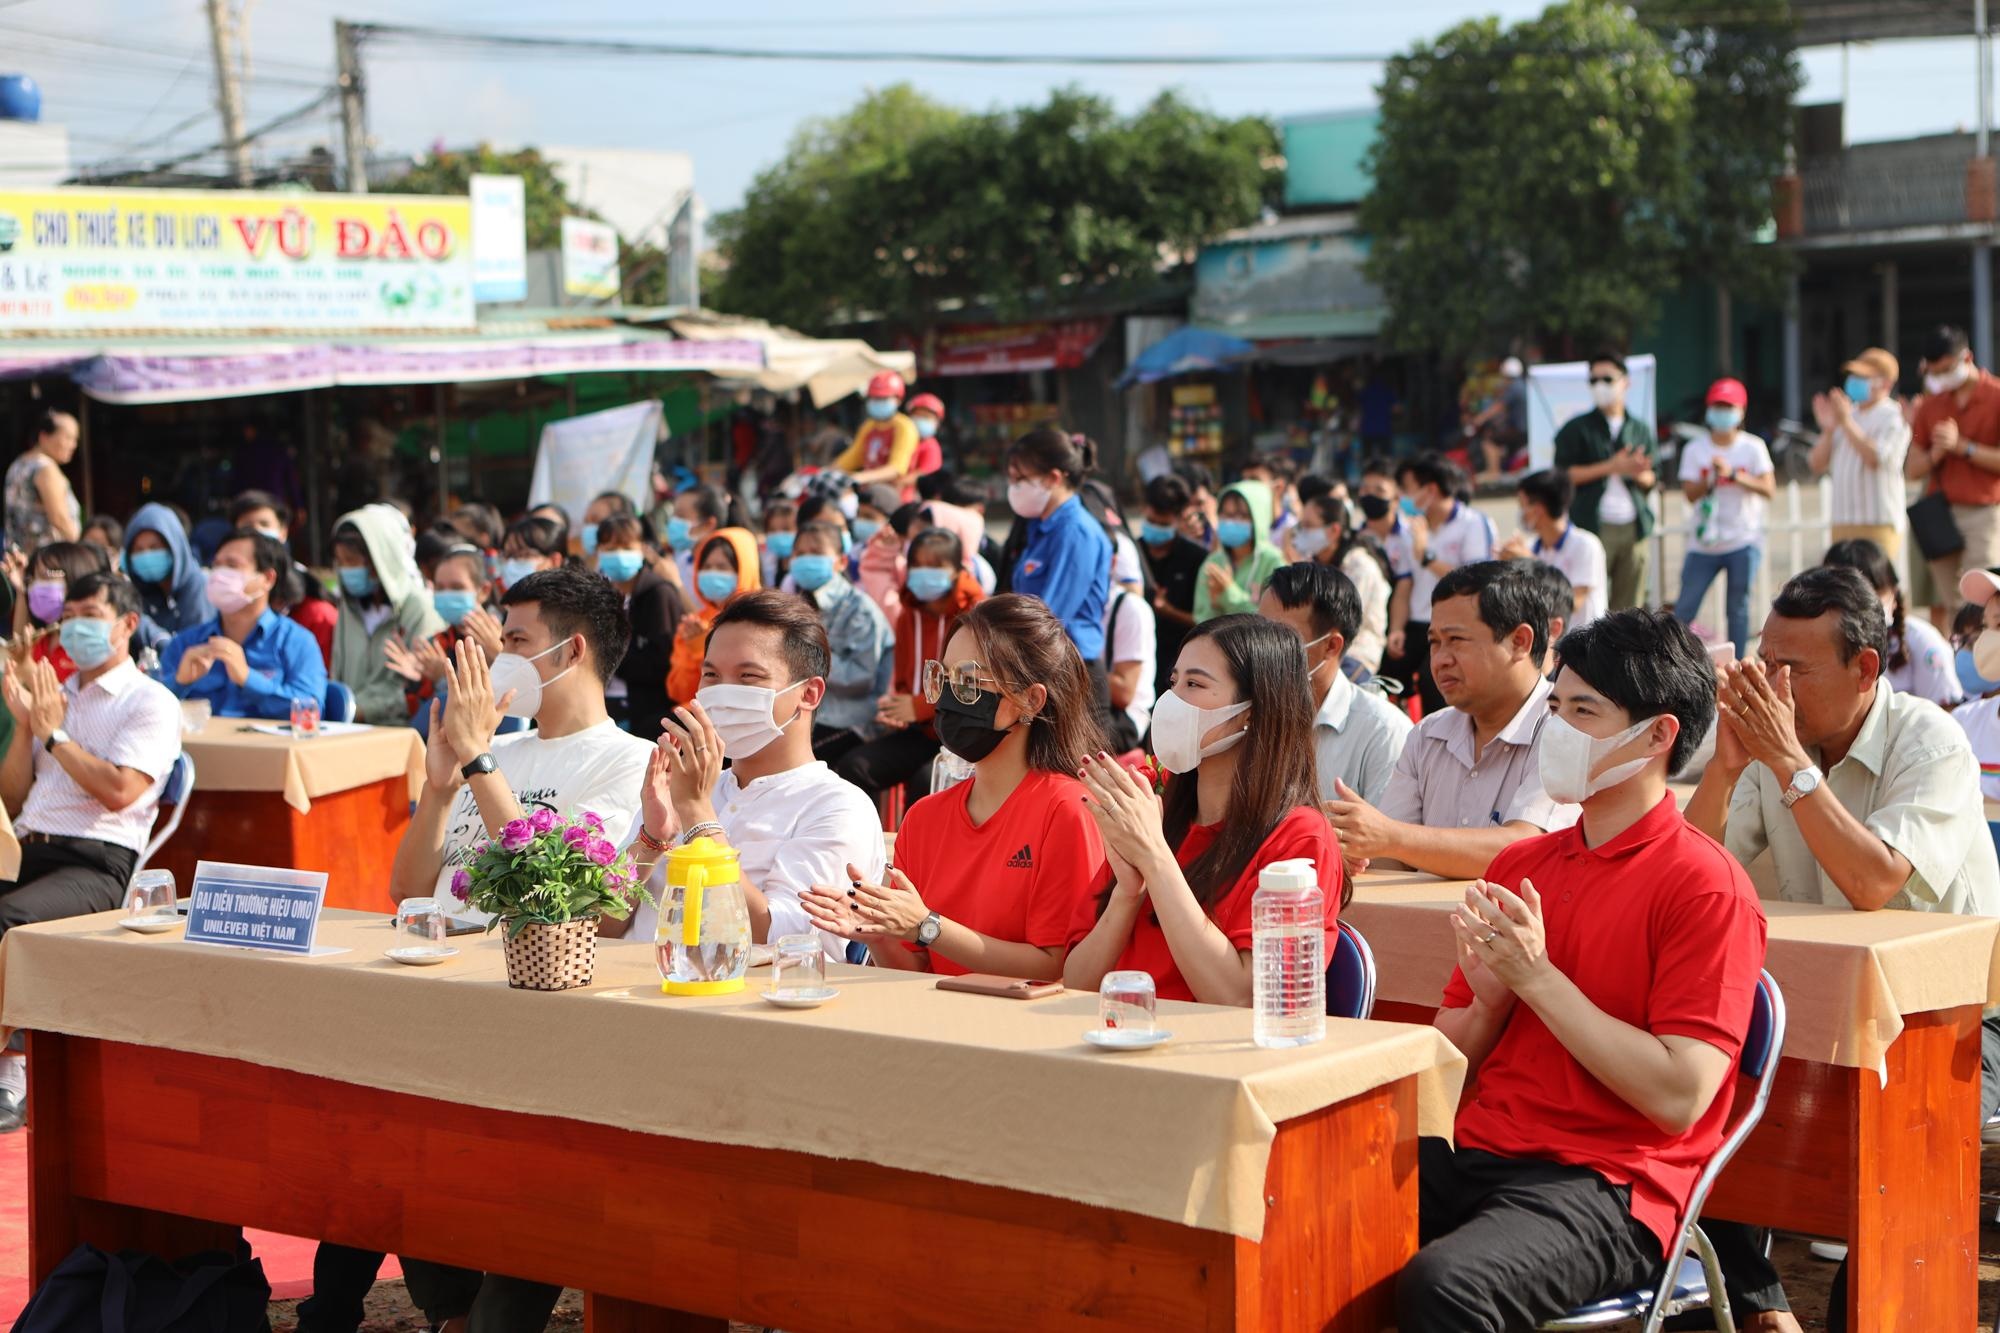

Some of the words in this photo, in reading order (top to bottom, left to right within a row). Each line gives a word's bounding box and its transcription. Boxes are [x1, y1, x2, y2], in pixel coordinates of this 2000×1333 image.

[34, 211, 68, 248] CHO
[154, 213, 177, 248] DU
[335, 207, 450, 260] ĐÀO
[1007, 860, 1033, 868] adidas
[212, 889, 234, 916] DIỆN
[269, 894, 292, 921] HIỆU
[291, 900, 314, 920] OMO
[203, 919, 249, 936] UNILEVER
[251, 921, 272, 941] VIỆT
[272, 926, 297, 941] NAM
